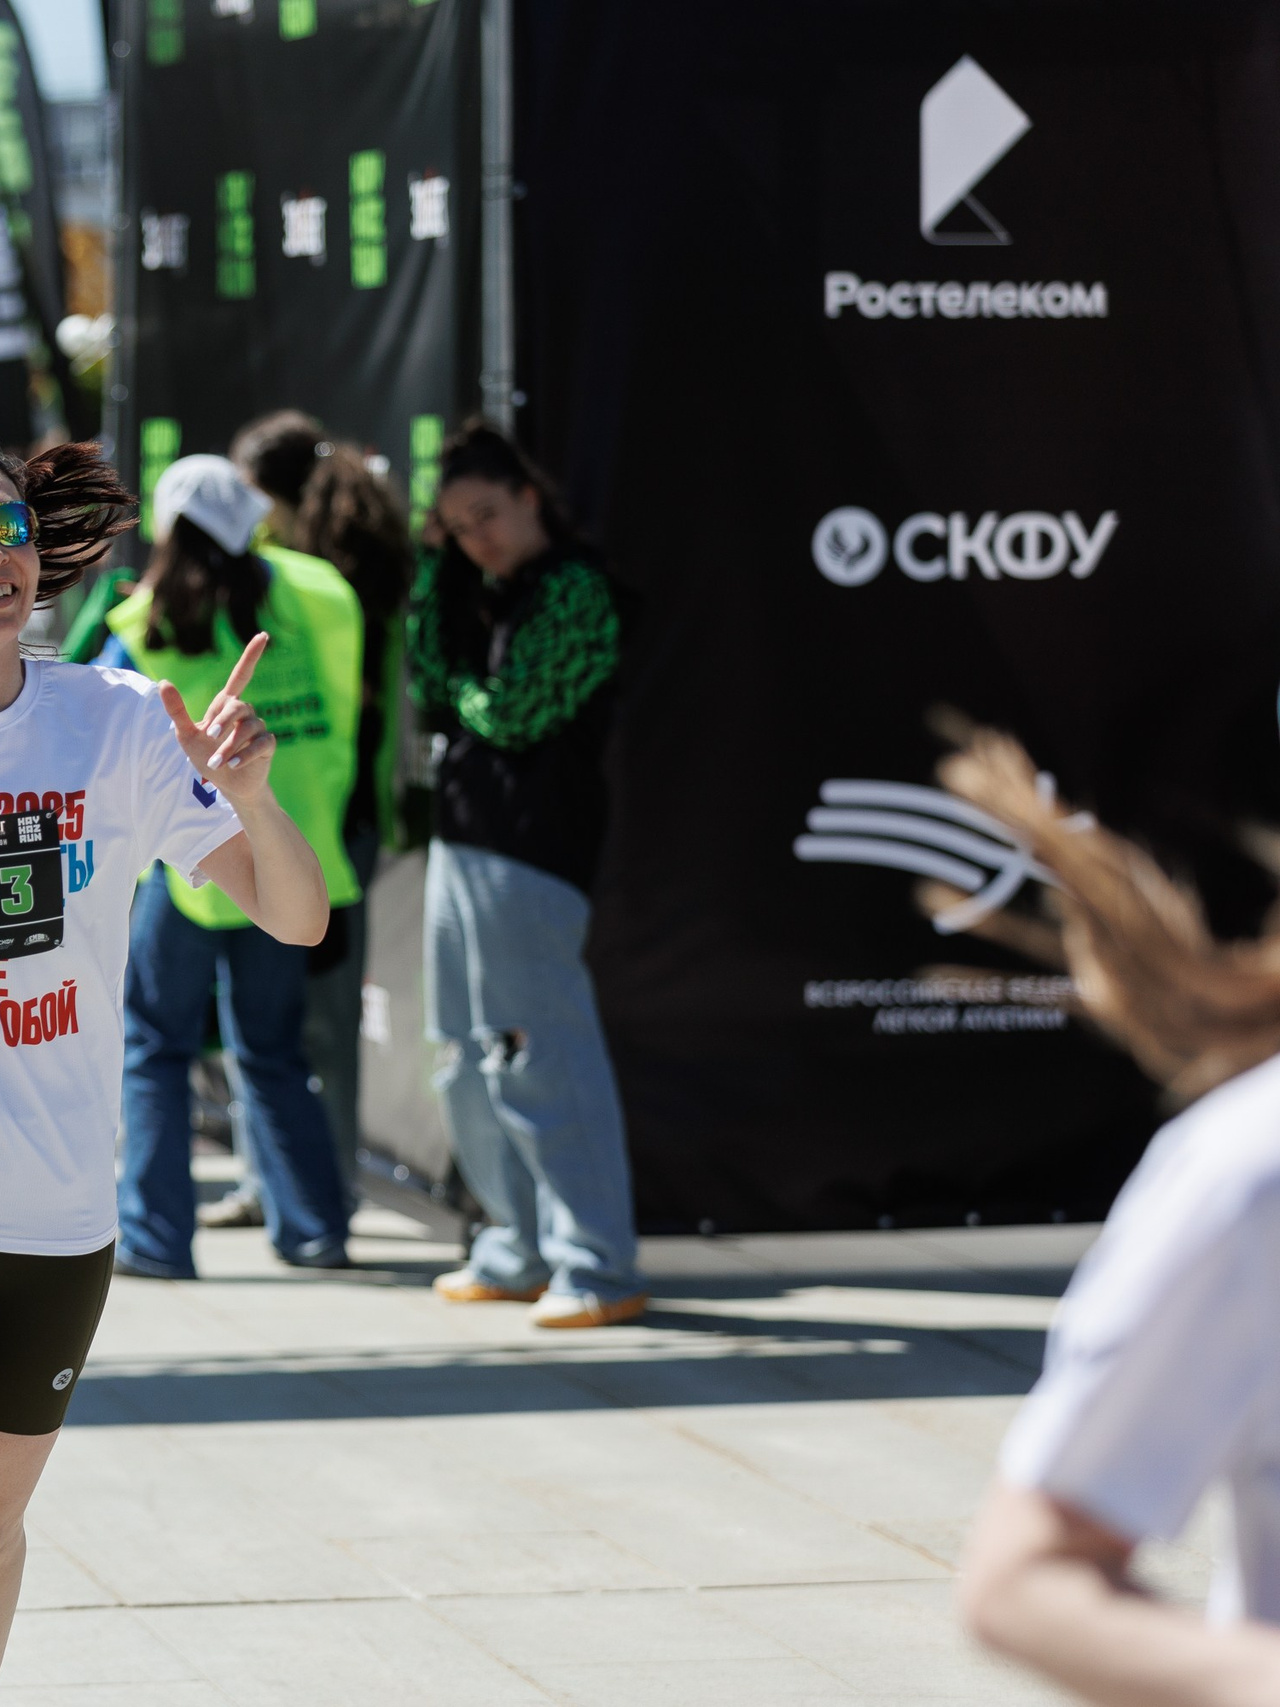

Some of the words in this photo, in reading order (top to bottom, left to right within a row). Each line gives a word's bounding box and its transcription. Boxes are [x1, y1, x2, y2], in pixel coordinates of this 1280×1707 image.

[824, 271, 1108, 318] Ростелеком
[893, 511, 1118, 582] СКФУ
[19, 832, 42, 844] RUN
